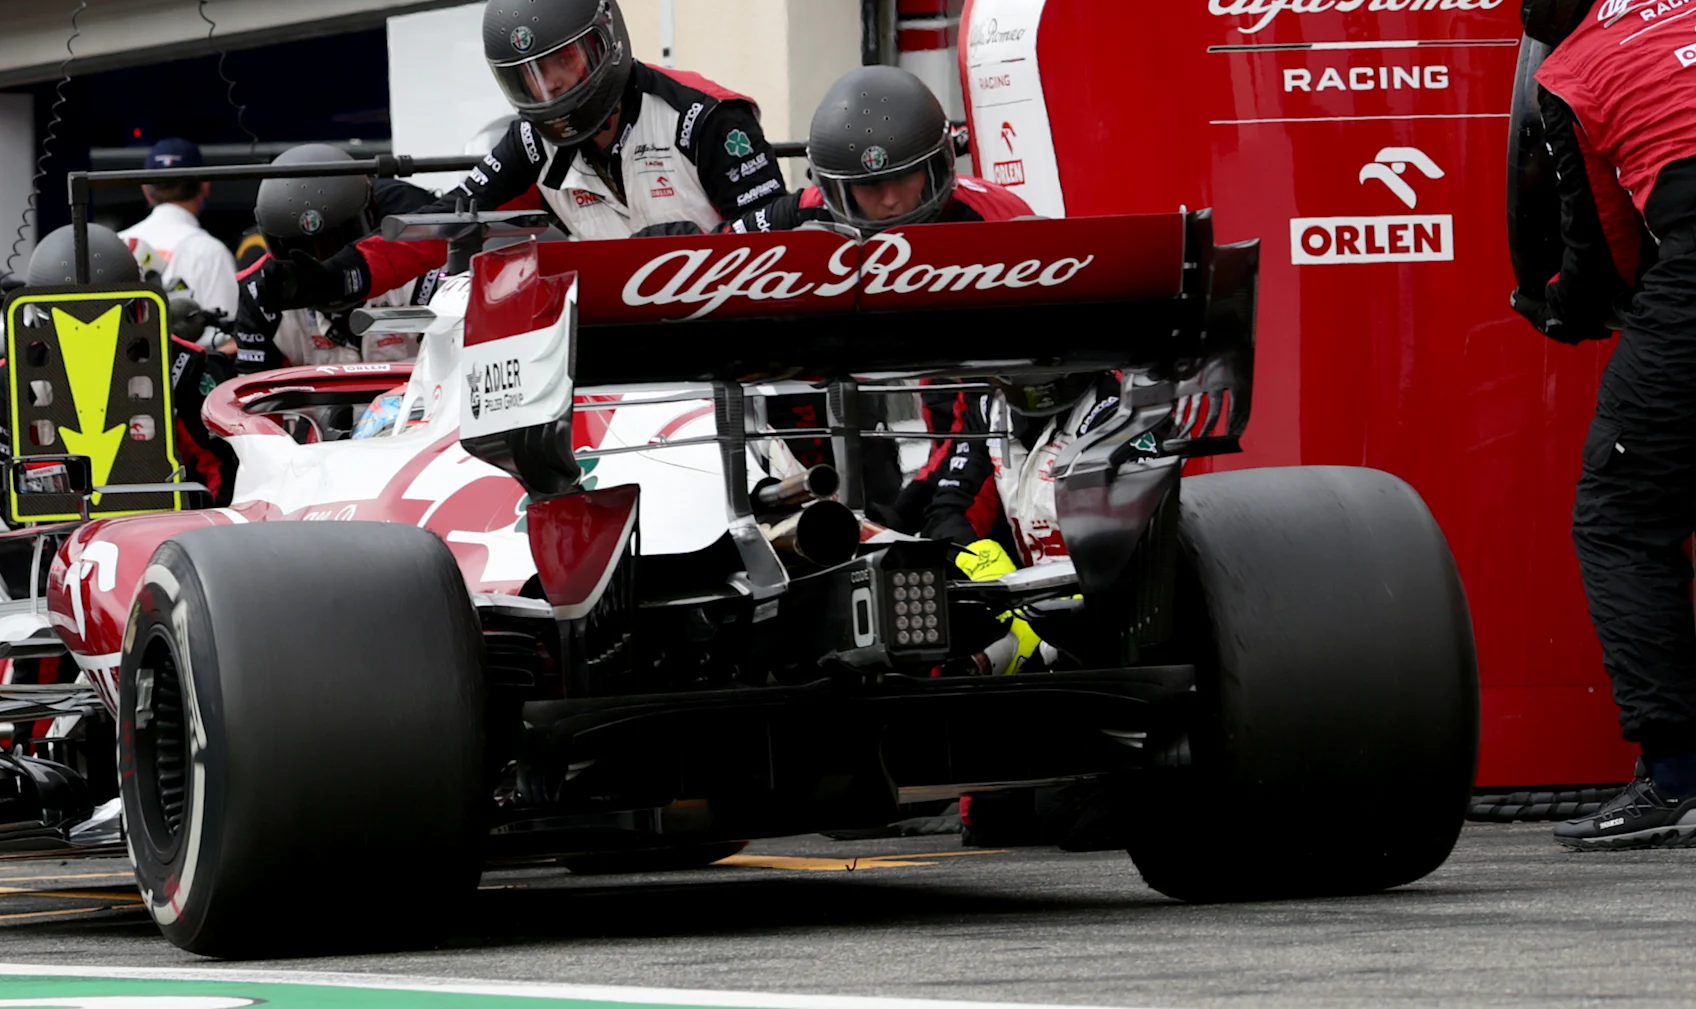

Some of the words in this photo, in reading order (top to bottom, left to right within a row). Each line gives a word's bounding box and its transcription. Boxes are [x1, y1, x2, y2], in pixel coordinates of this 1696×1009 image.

[978, 75, 1010, 90] RACING
[1283, 65, 1449, 92] RACING
[520, 121, 540, 164] sparco
[680, 102, 703, 149] sparco
[1301, 223, 1442, 256] ORLEN
[622, 245, 815, 320] Alfa
[812, 233, 1095, 298] Romeo
[485, 359, 521, 394] ADLER
